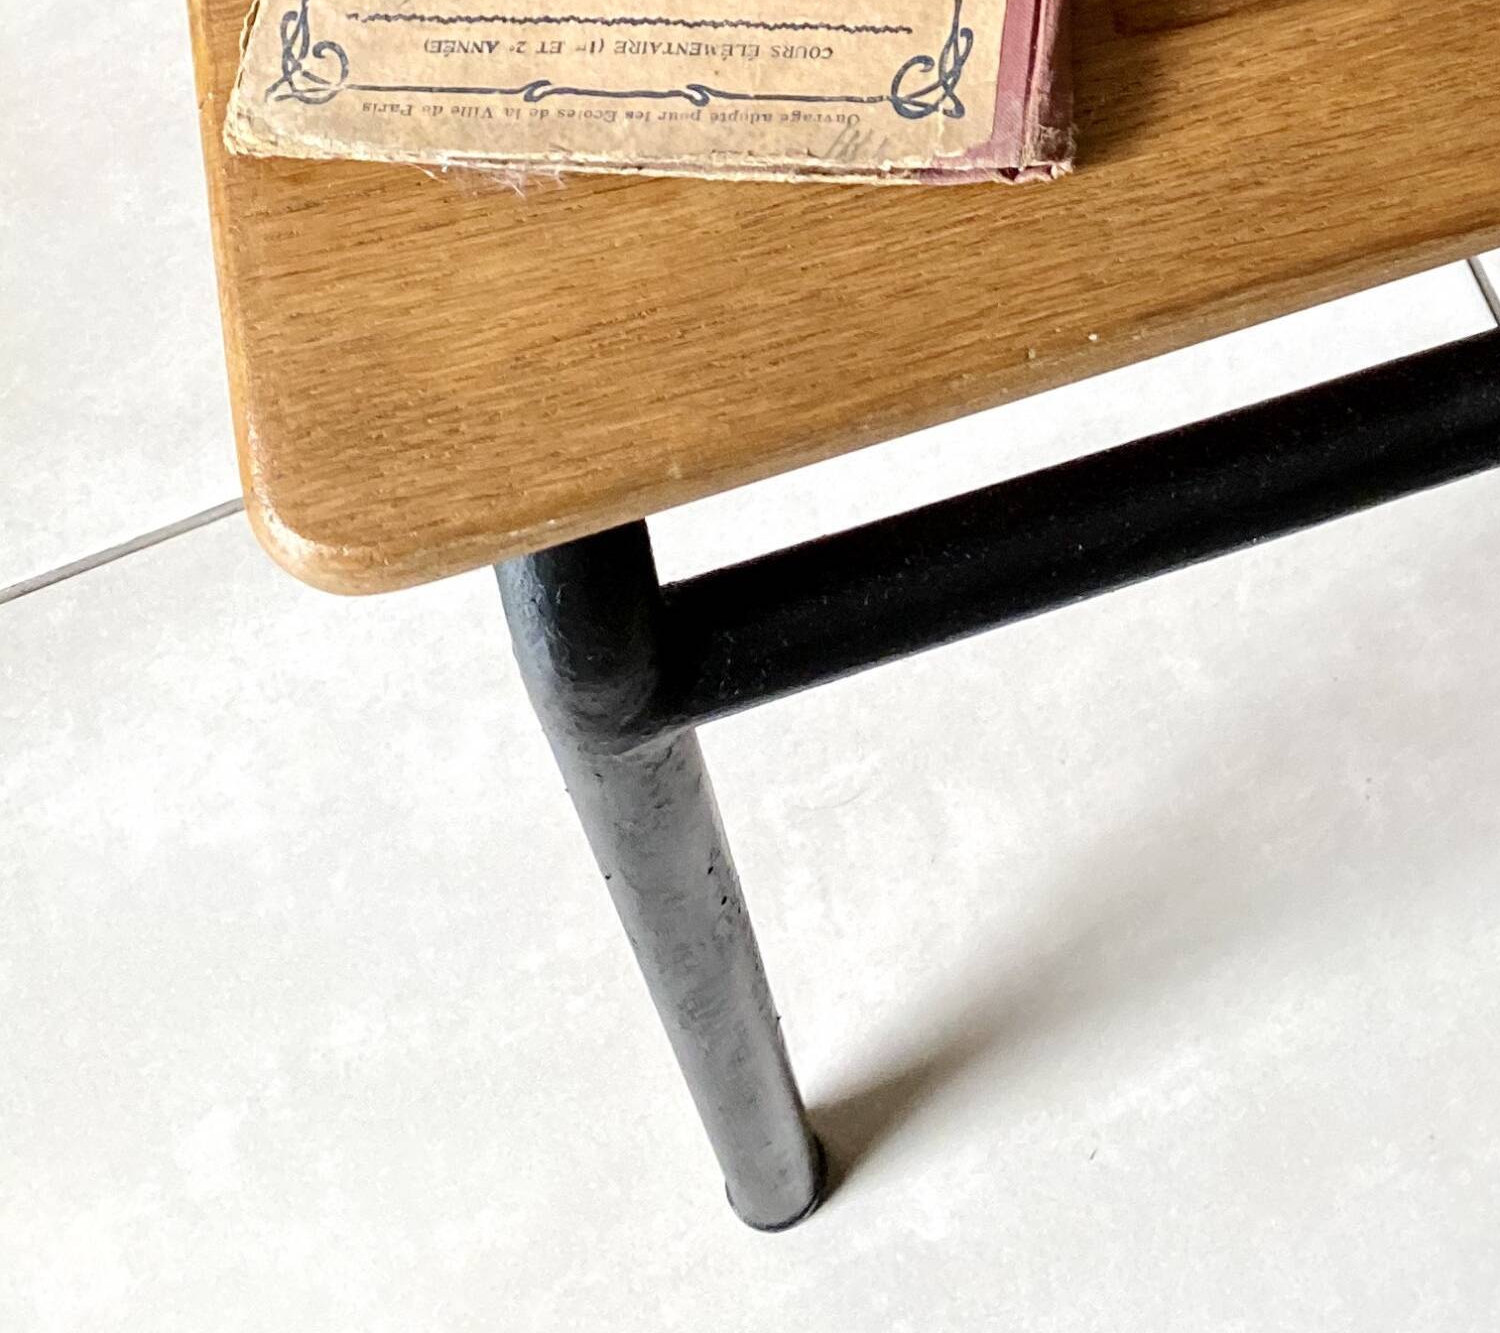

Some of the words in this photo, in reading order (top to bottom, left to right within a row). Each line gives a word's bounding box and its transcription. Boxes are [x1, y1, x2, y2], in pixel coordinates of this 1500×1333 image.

[422, 37, 500, 59] ANNÉE)
[535, 39, 562, 55] ET
[613, 38, 760, 64] ÉLÉMENTAIRE
[770, 44, 834, 61] COURS
[361, 101, 412, 120] Paris
[449, 103, 494, 122] Ville
[623, 109, 651, 125] les
[777, 107, 861, 127] Ouvrage
